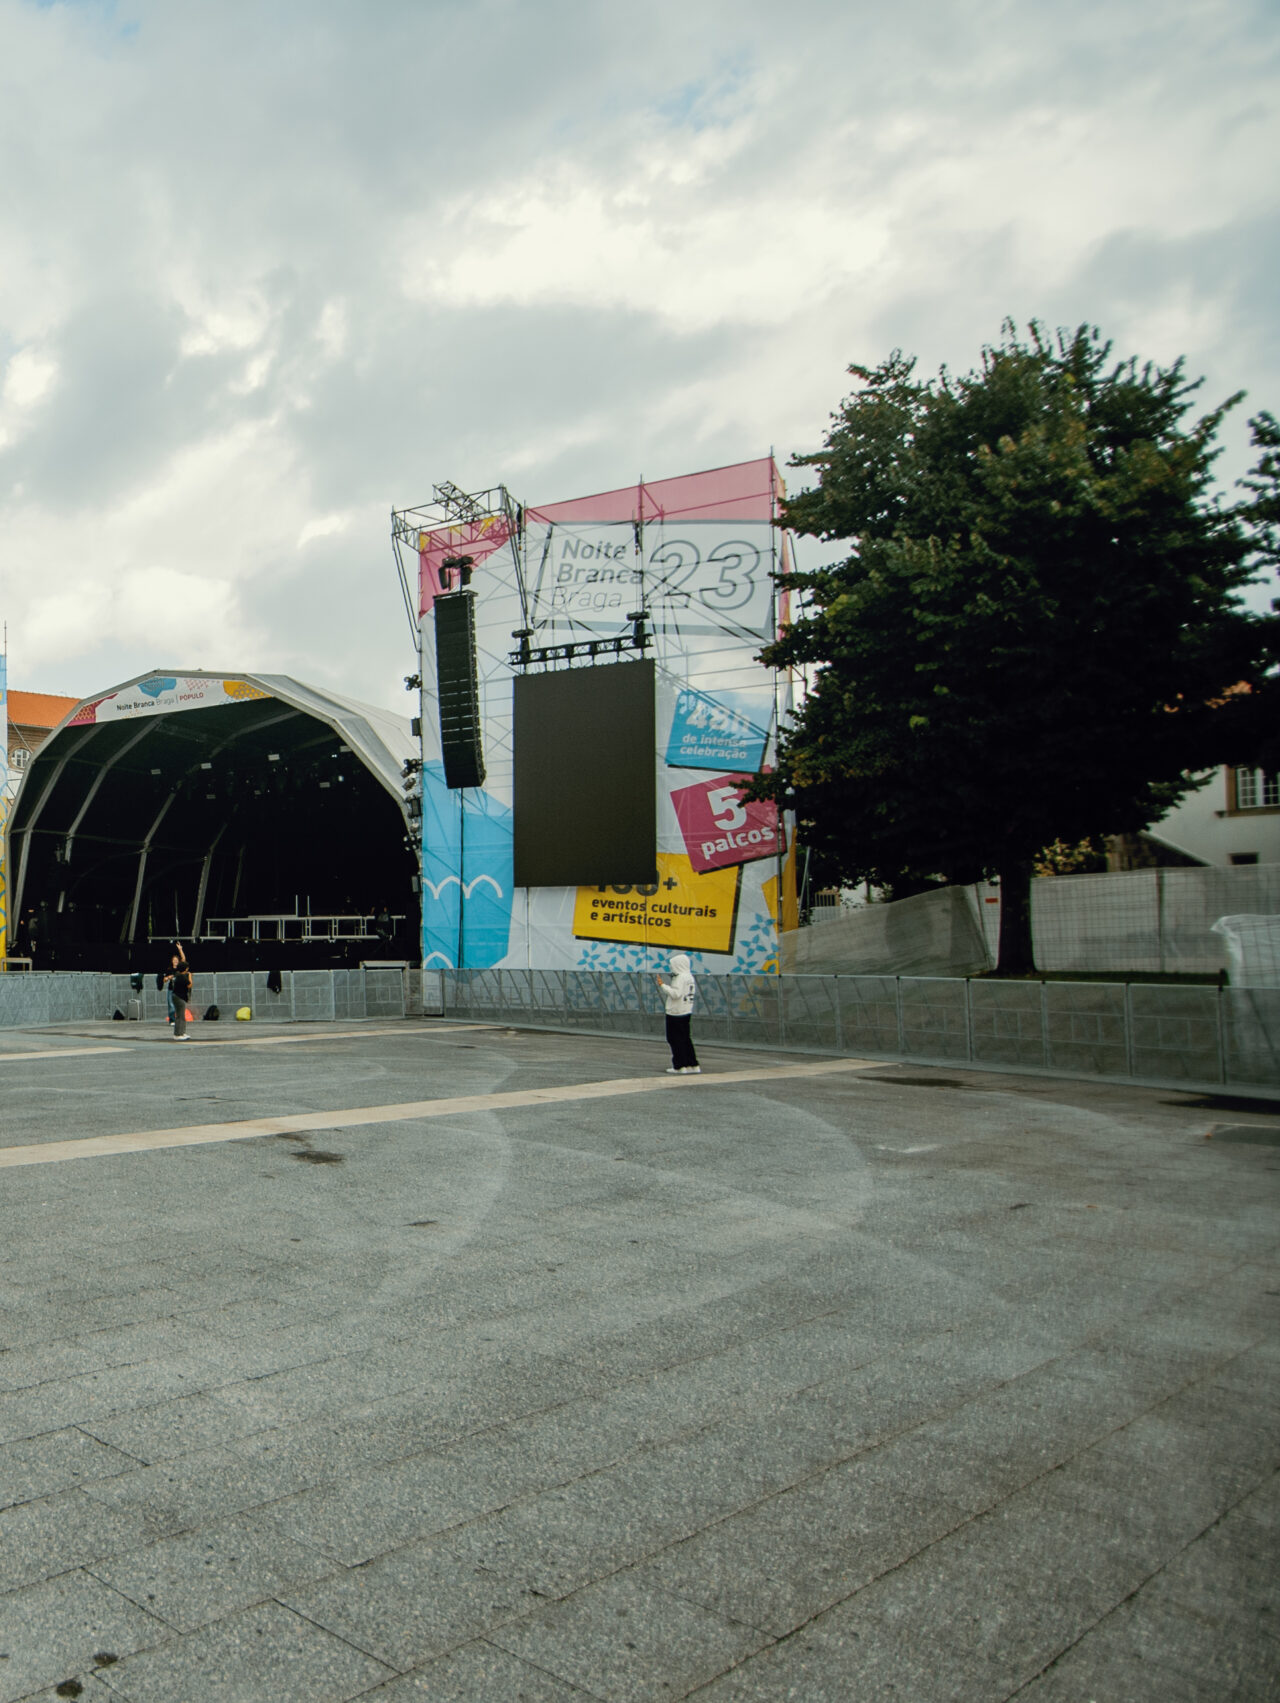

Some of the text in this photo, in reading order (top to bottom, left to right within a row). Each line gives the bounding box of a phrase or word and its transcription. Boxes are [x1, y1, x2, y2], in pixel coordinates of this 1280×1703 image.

[561, 539, 627, 560] Noite
[557, 563, 643, 585] Branca
[646, 540, 760, 611] 23
[552, 586, 622, 612] Braga
[116, 703, 133, 711] Noite
[133, 700, 155, 709] Branca
[682, 733, 697, 743] de
[679, 746, 747, 760] celebração
[707, 786, 747, 831] 5
[701, 826, 775, 860] palcos
[590, 910, 672, 927] e artísticos
[591, 899, 717, 918] eventos culturais
